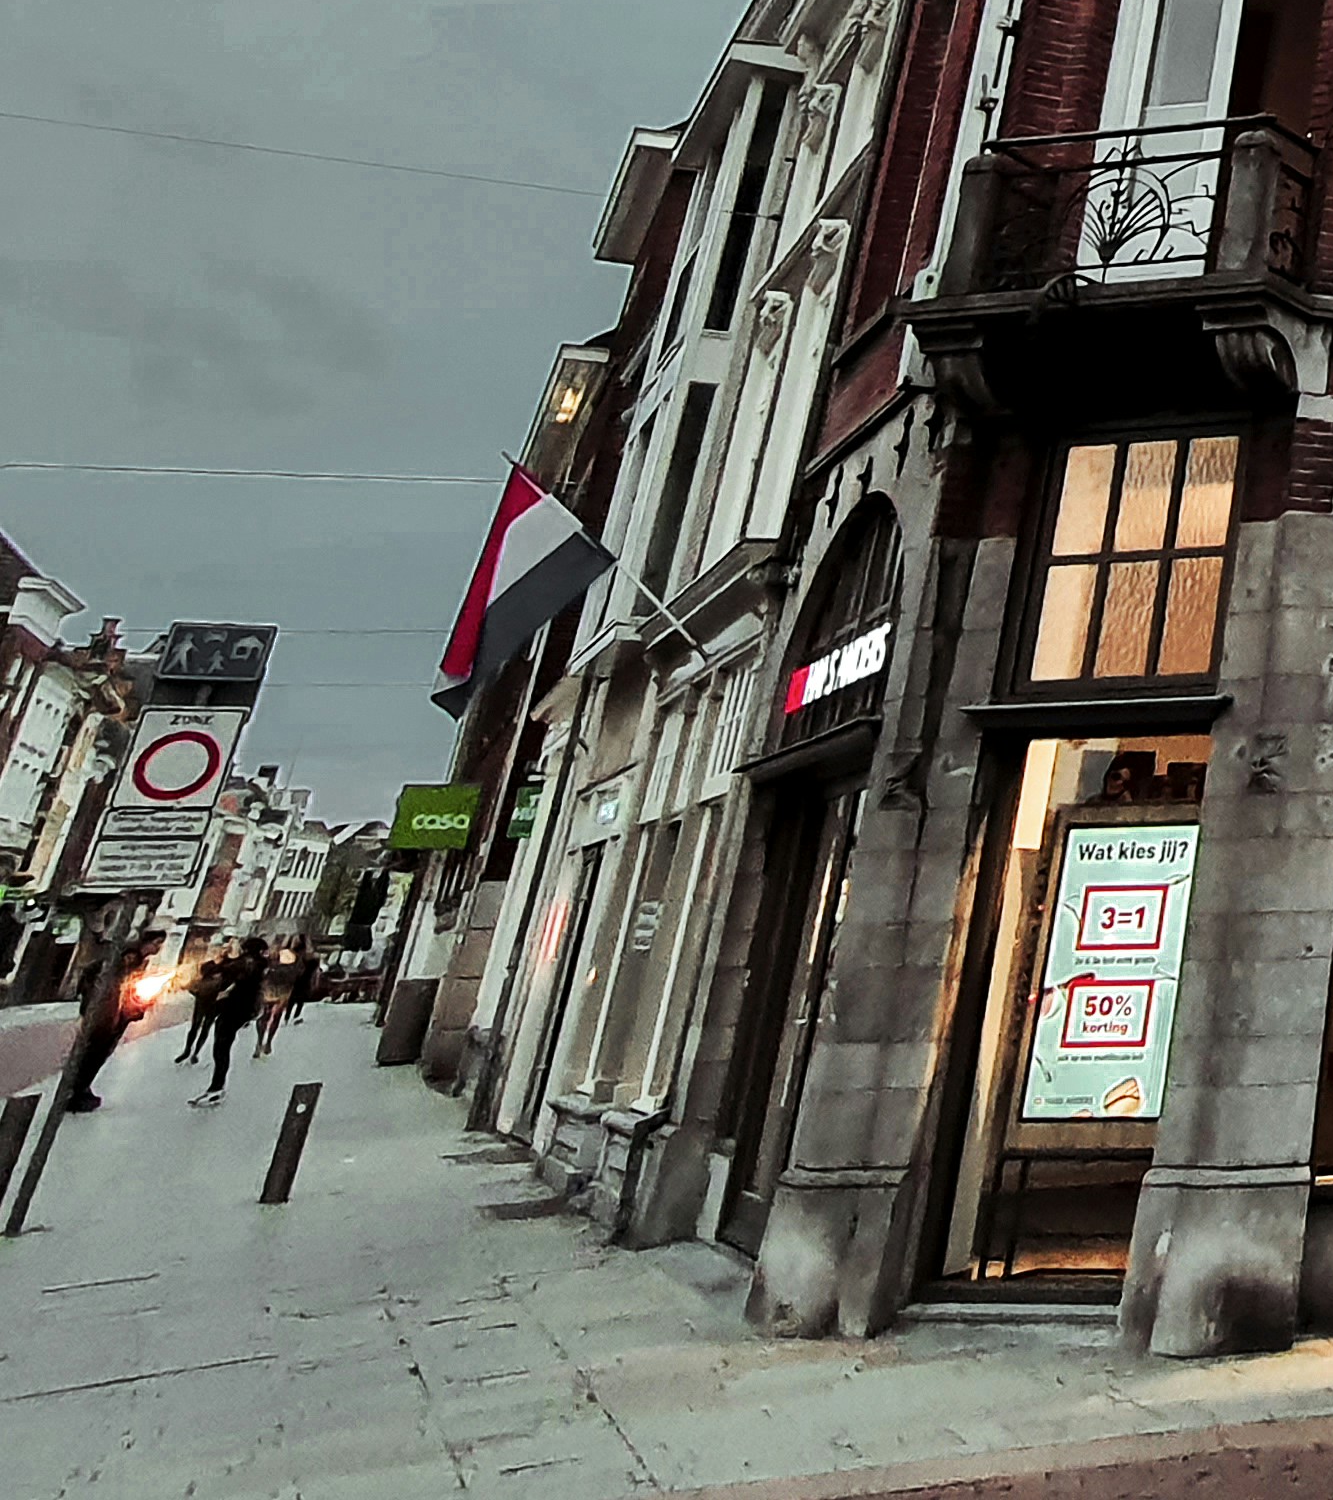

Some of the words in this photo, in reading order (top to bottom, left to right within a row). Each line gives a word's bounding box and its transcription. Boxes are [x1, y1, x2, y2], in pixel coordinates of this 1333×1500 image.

[411, 813, 471, 831] casa
[1078, 843, 1114, 861] Wat
[1117, 841, 1156, 860] kies
[1158, 839, 1189, 864] jij?
[1100, 905, 1146, 930] 3=1
[1084, 994, 1133, 1017] 50%
[1081, 1020, 1129, 1036] korting
